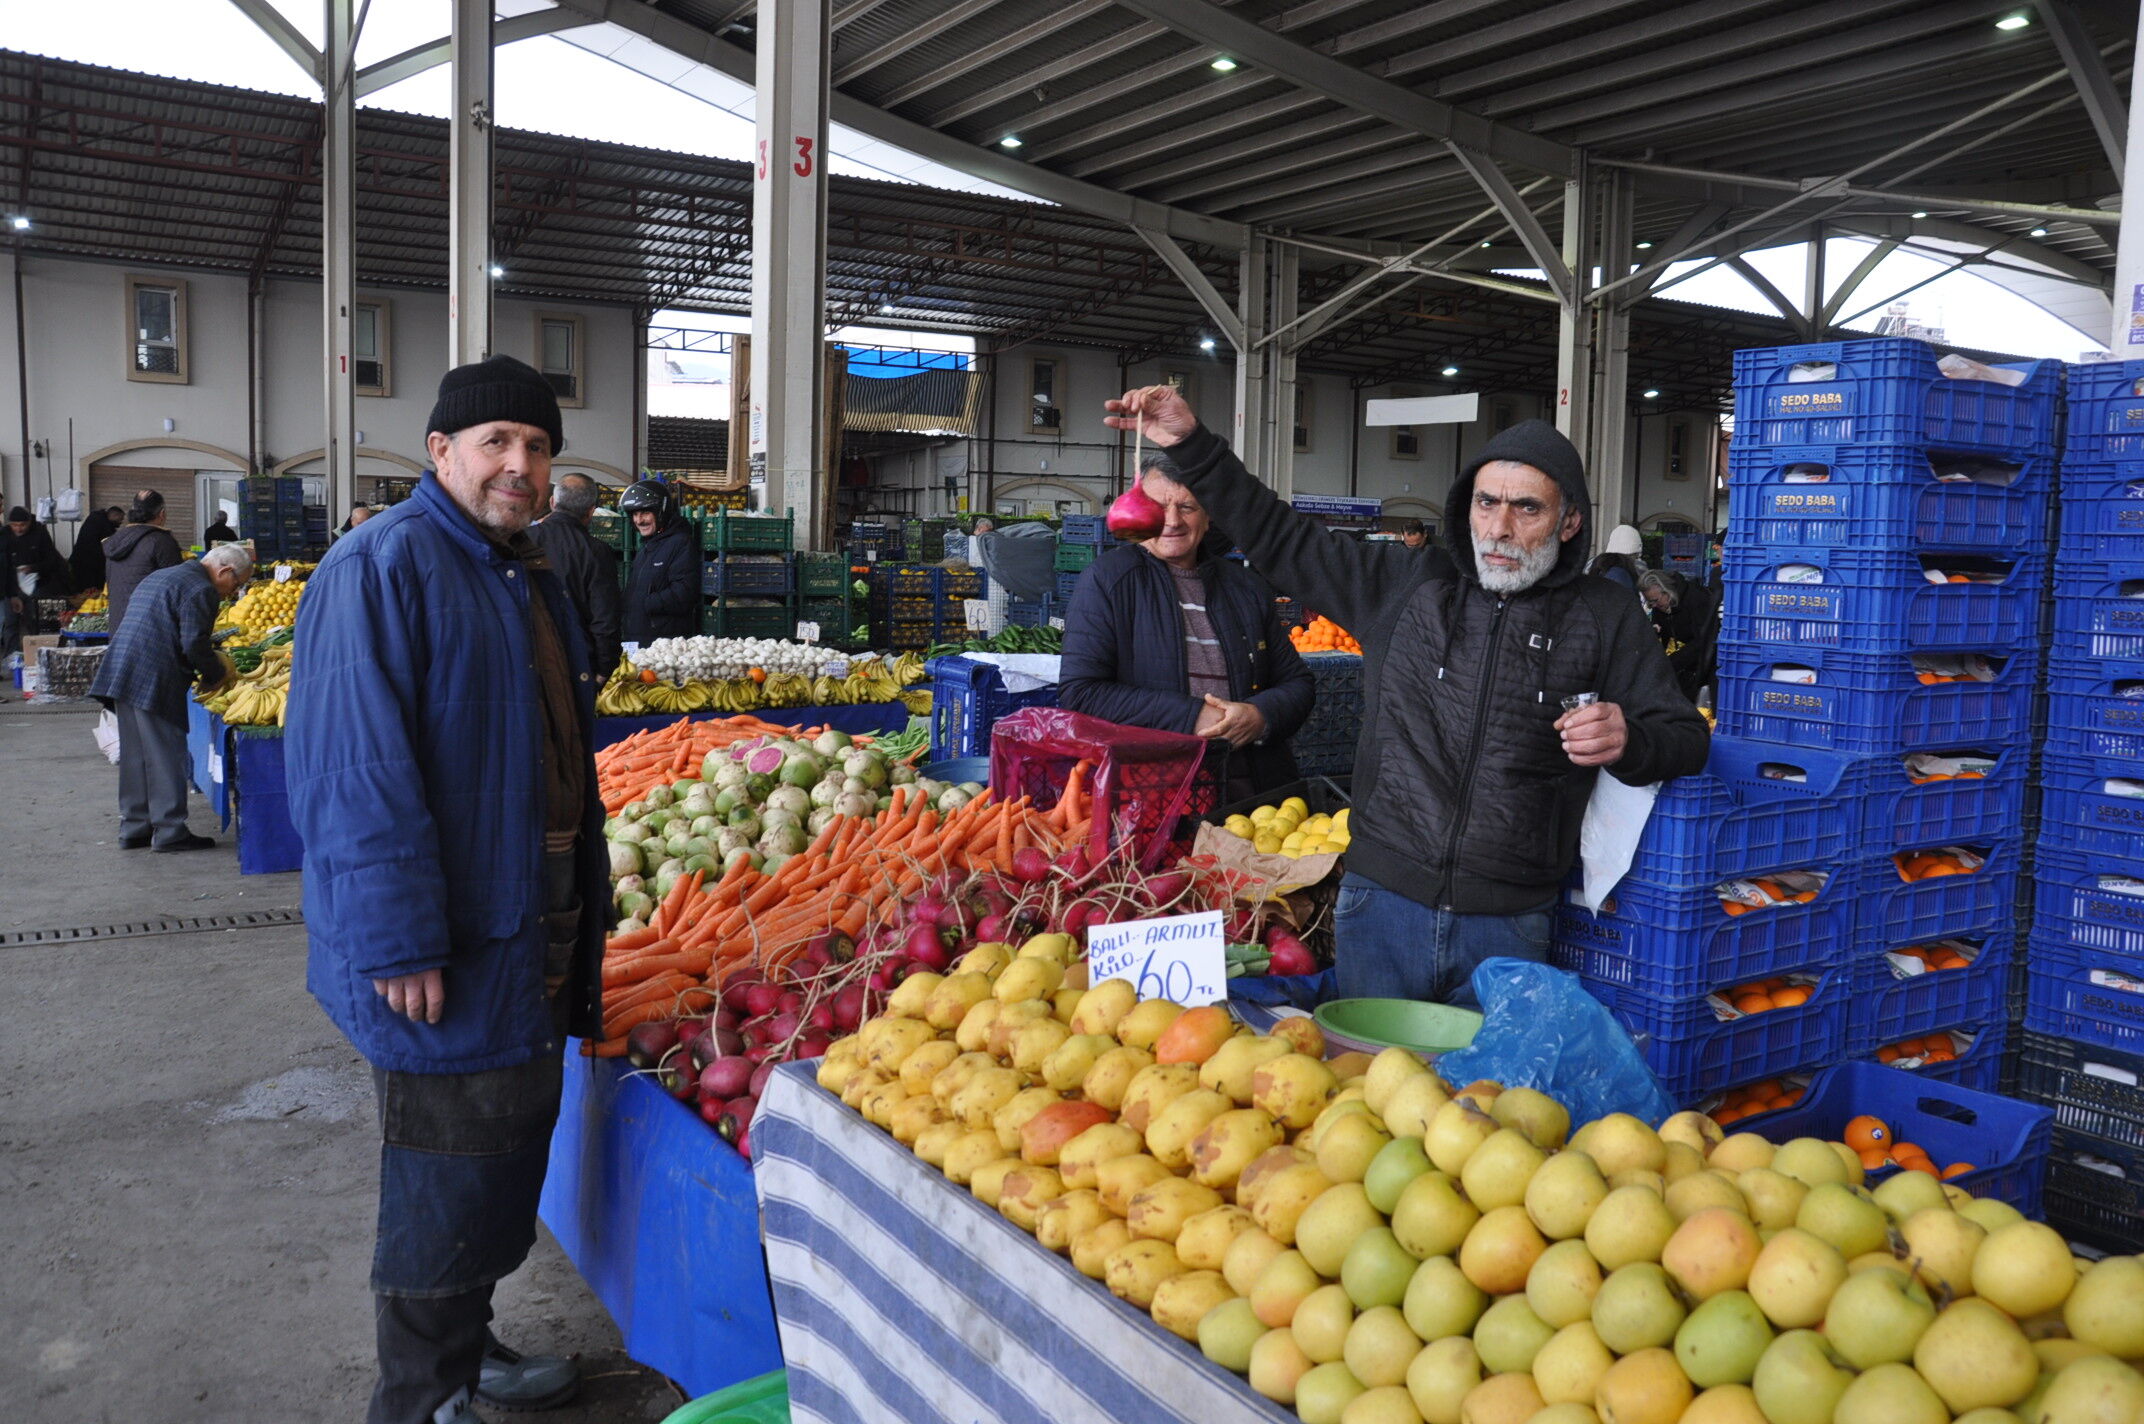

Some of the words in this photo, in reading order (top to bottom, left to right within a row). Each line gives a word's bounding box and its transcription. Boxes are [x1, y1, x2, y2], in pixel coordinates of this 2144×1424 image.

[759, 140, 767, 180] 3
[794, 136, 813, 177] 3
[340, 355, 347, 374] 1
[1561, 389, 1568, 405] 2
[1780, 394, 1810, 407] SEDO
[1812, 392, 1842, 405] BABA
[2126, 408, 2144, 420] SE
[1774, 494, 1804, 507] SEDO
[1806, 494, 1837, 507] BABA
[1768, 593, 1797, 606] SEDO
[1800, 595, 1829, 608] BABA
[1763, 690, 1791, 704] SEDO
[1793, 694, 1823, 708] BABA
[2104, 708, 2137, 721] SEDO
[2097, 805, 2130, 819] SEDO
[1593, 925, 1623, 941] BABA
[1137, 949, 1193, 1004] 60
